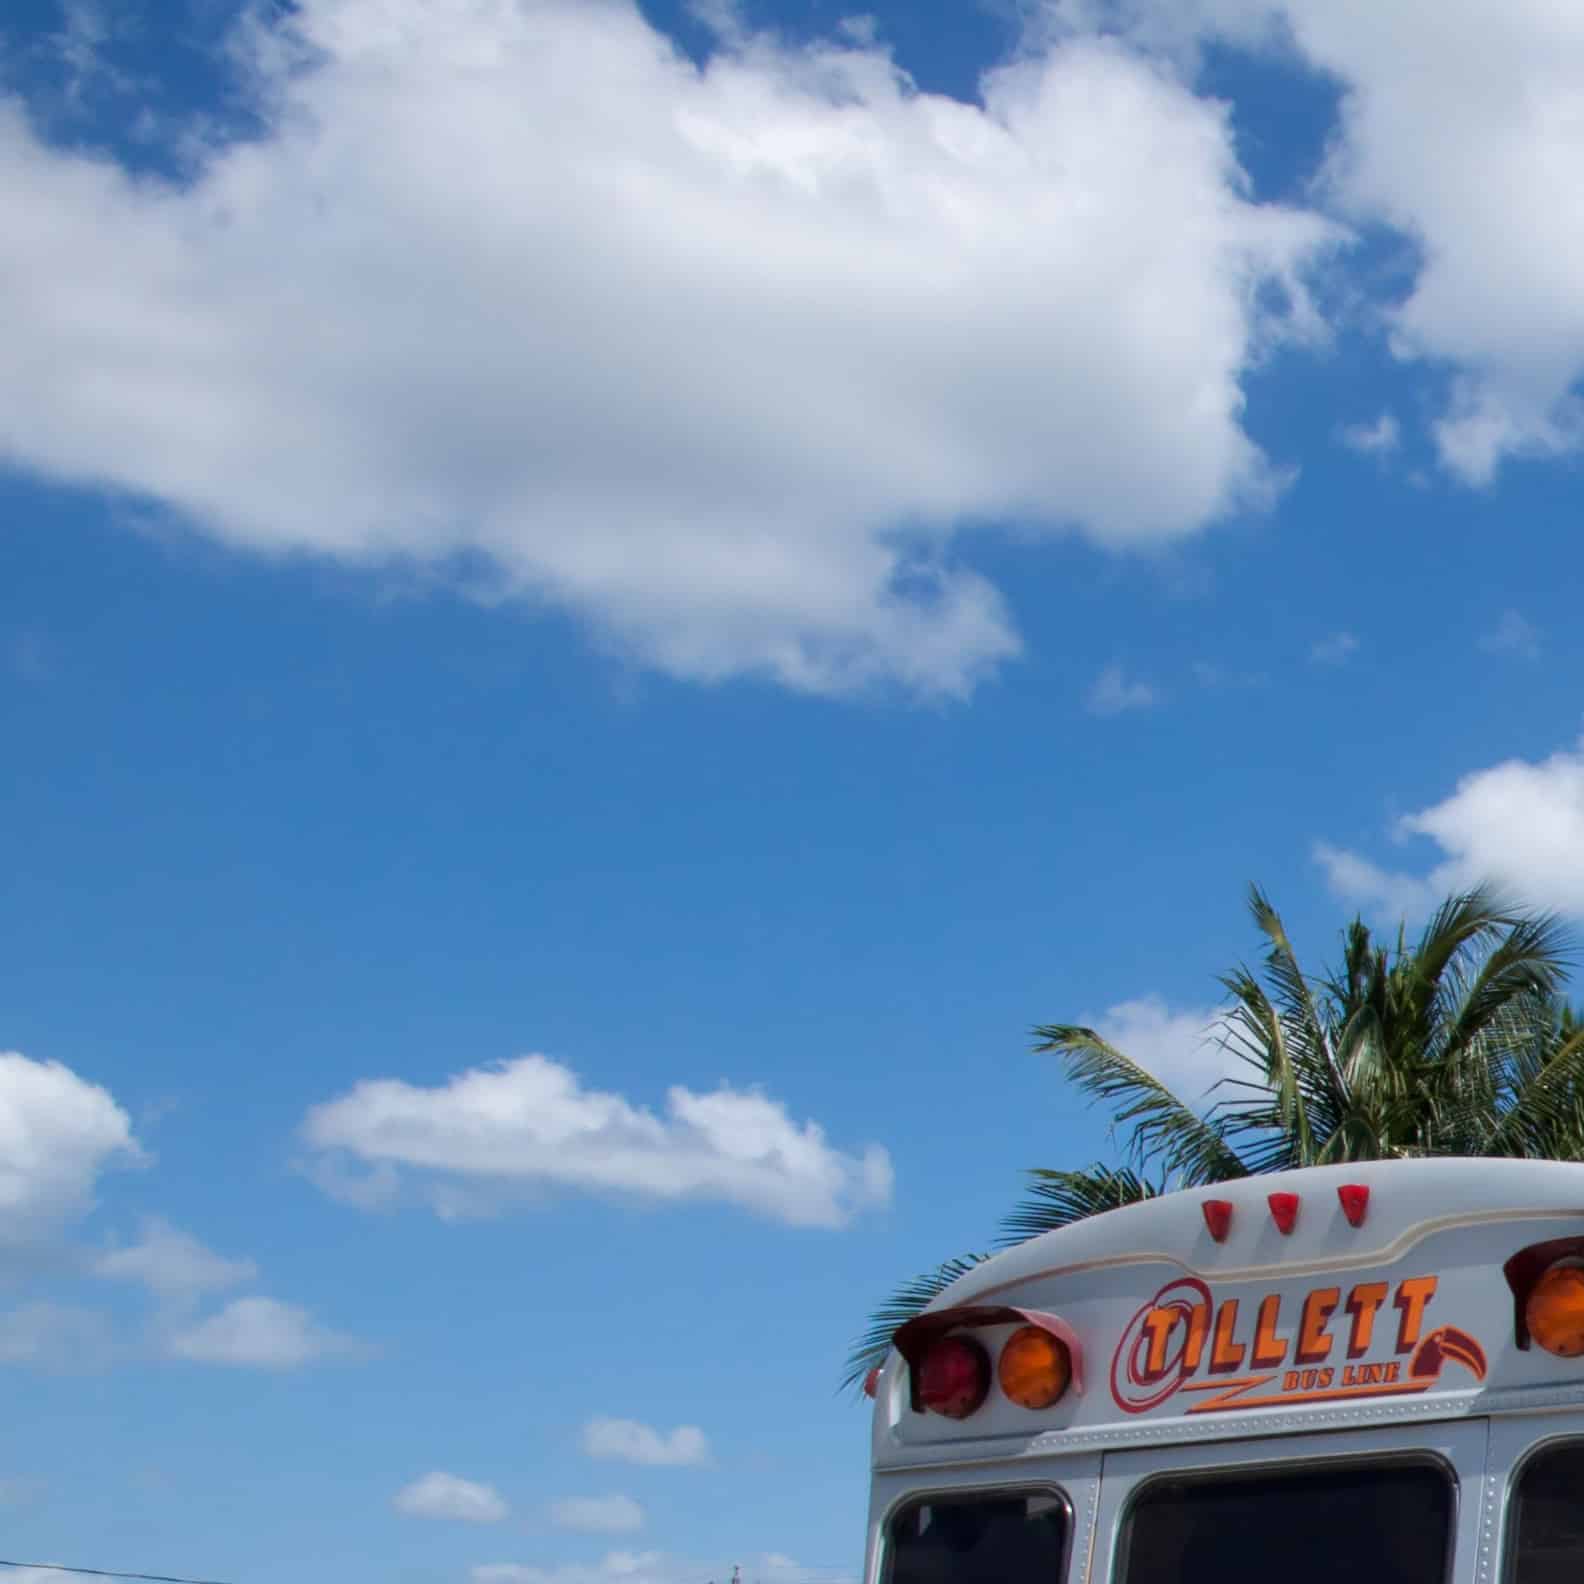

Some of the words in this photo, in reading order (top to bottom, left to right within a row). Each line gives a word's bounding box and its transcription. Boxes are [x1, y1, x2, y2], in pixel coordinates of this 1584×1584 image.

[1143, 1276, 1439, 1382] TILLETT
[1282, 1365, 1335, 1392] BUS
[1341, 1361, 1401, 1386] LINE
